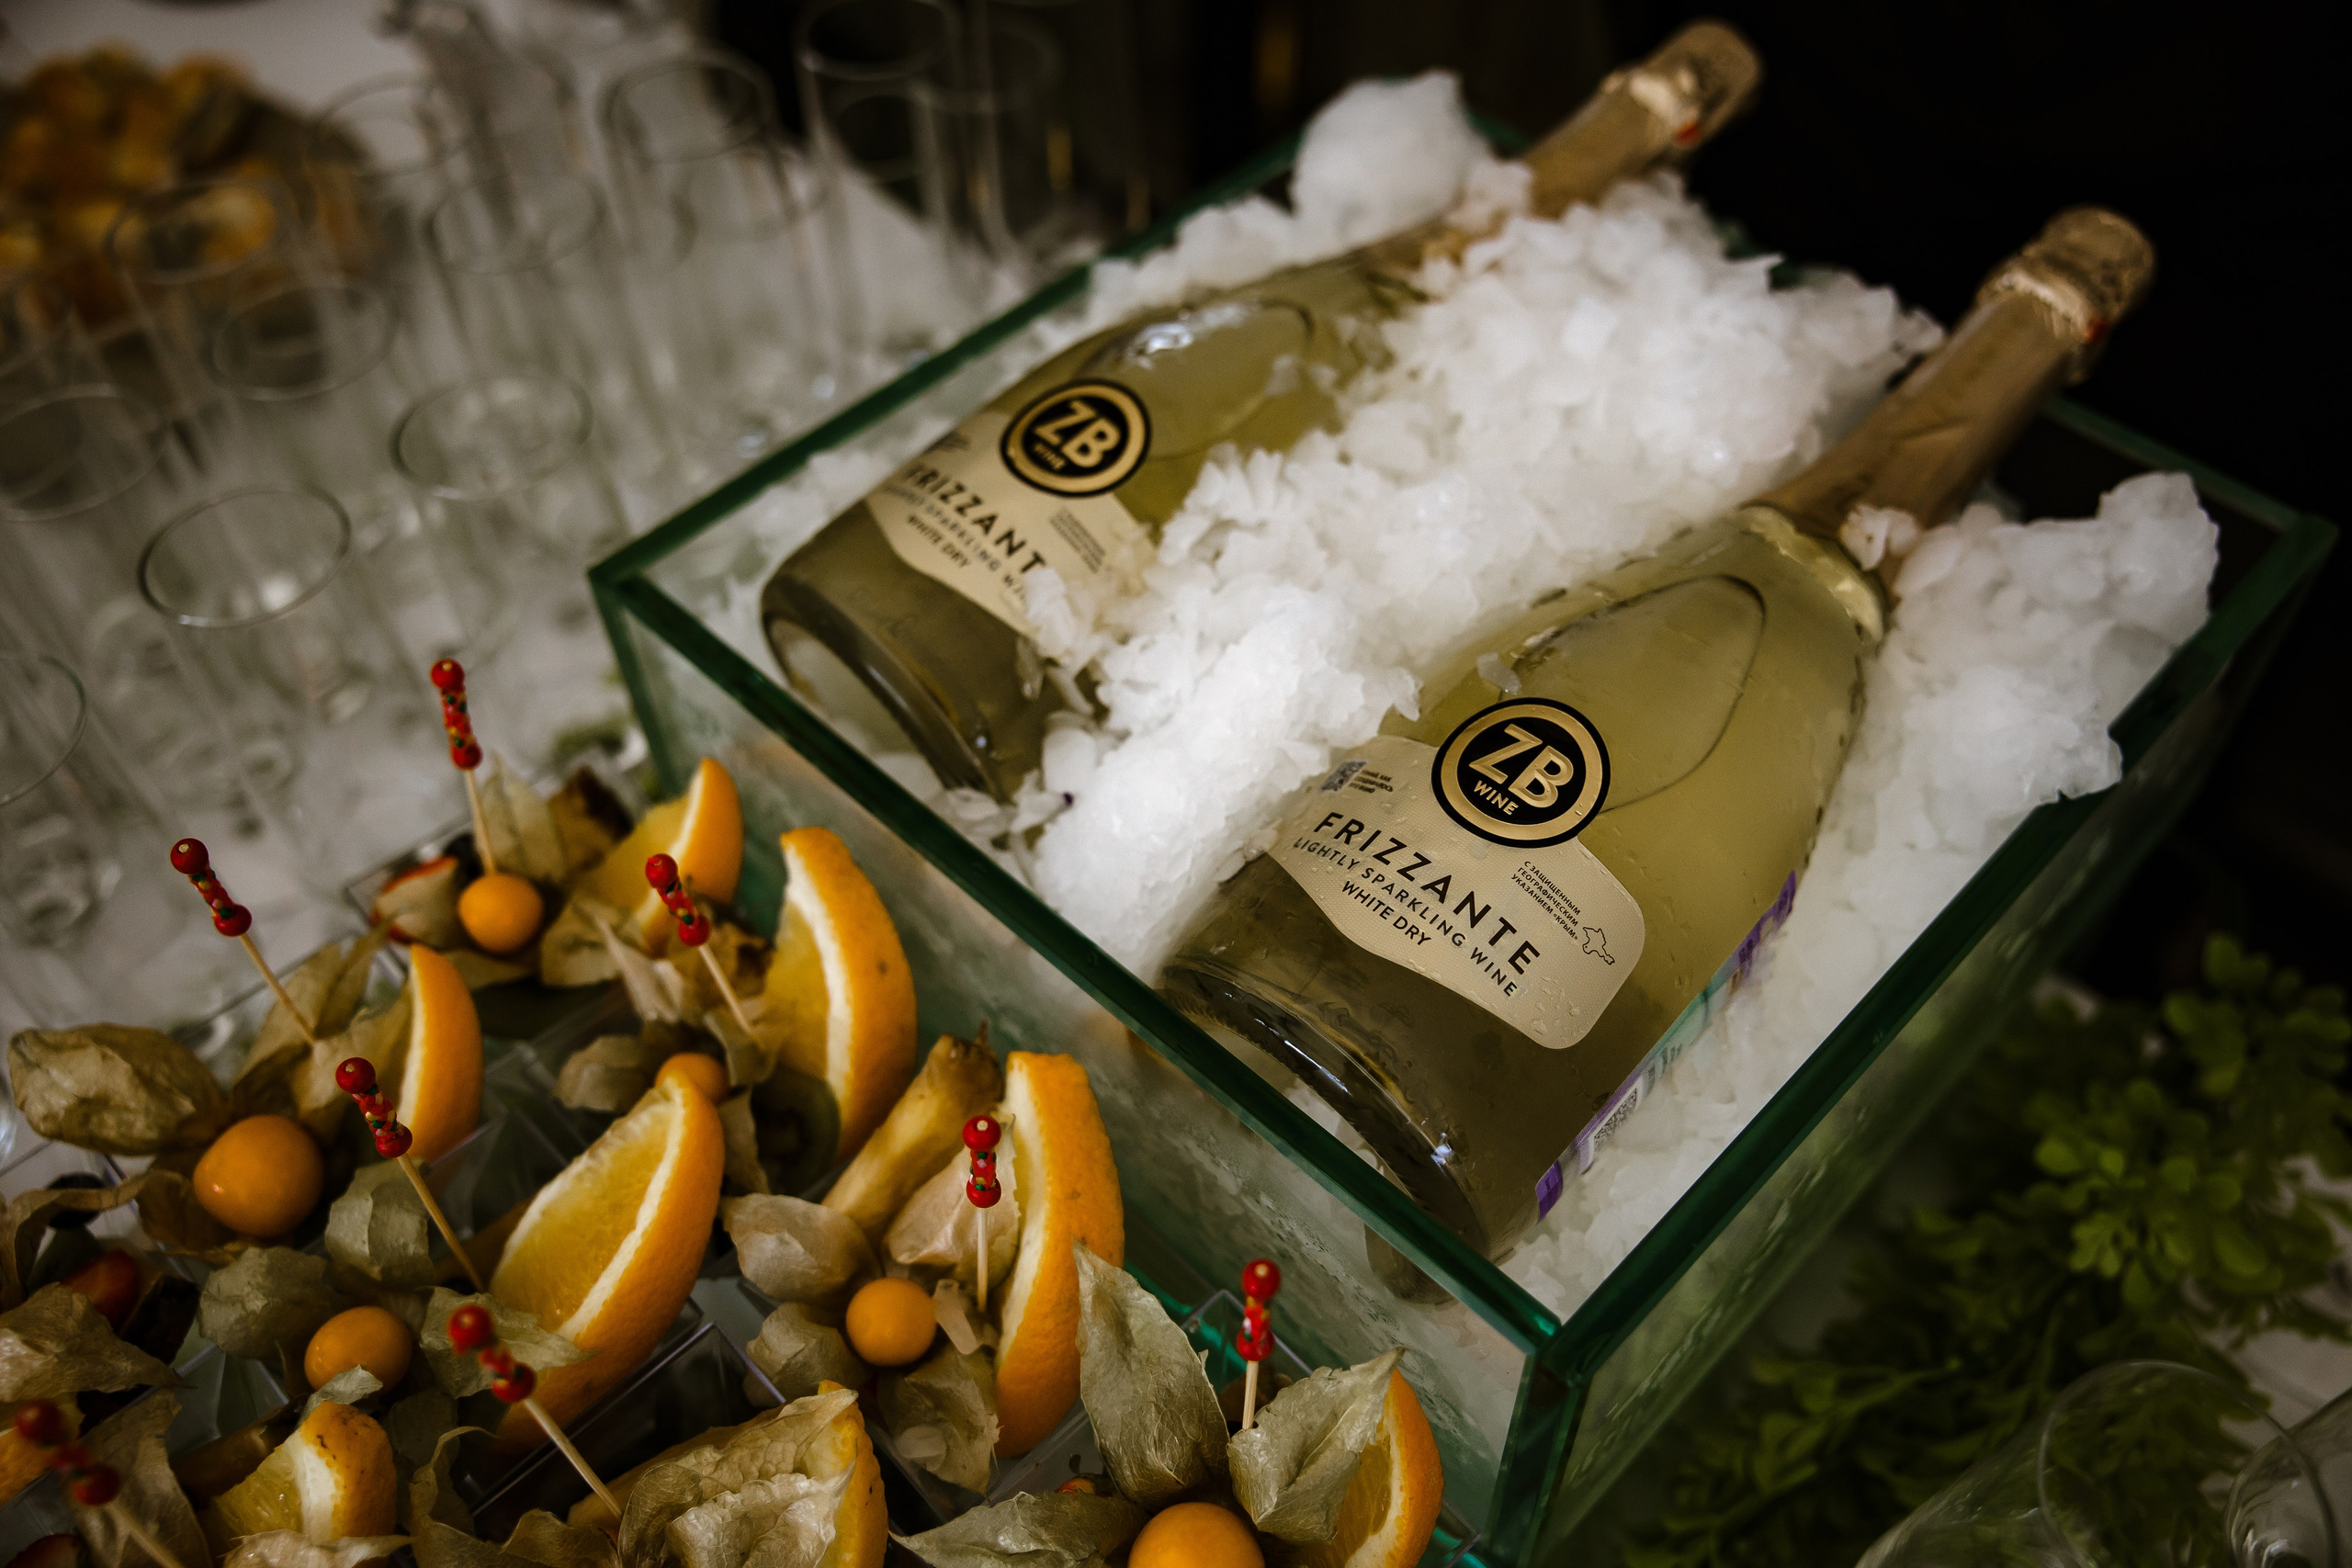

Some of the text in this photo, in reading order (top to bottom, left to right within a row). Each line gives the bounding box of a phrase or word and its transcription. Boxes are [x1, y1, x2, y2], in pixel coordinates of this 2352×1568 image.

[1034, 400, 1122, 468] ZB
[904, 464, 1047, 573] FRIZZANT
[1468, 723, 1575, 809] ZB
[1473, 779, 1520, 816] WINE
[1292, 836, 1519, 998] LIGHTLY SPARKLING WINE
[1313, 810, 1542, 976] FRIZZANTE
[1341, 879, 1432, 947] WHITE DRY
[1510, 874, 1578, 941] УКАЗАНИЕМ «КРЫМ»
[1517, 866, 1579, 927] ГЕОГРАФИЧЕСКИМ
[1530, 865, 1580, 915] ЗАЩИЩЕННЫМ
